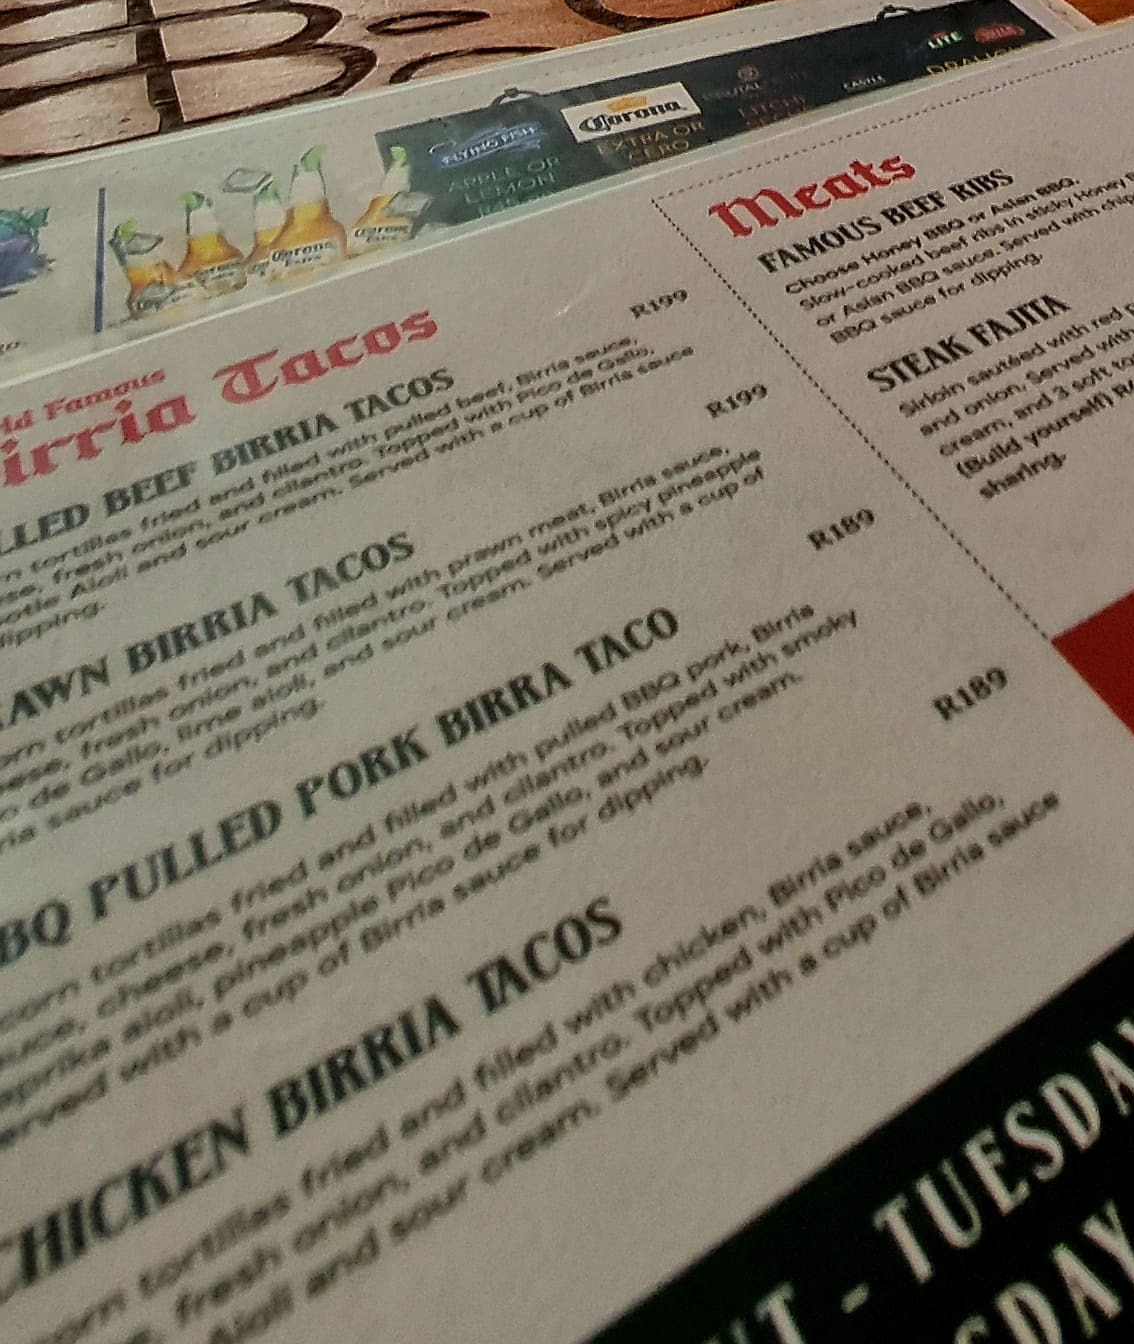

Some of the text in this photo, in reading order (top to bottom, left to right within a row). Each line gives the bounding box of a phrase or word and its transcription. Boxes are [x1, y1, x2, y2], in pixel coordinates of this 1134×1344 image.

[578, 100, 685, 134] Corona
[673, 119, 706, 138] OR
[707, 154, 916, 237] Meats
[756, 168, 1014, 273] FAMOUS BEEF RIBS
[629, 289, 688, 319] R199
[866, 294, 1071, 392] STEAK FAJITA
[0, 309, 438, 487] irria Tacos
[704, 383, 767, 418] R199
[807, 508, 875, 550] R189
[0, 657, 110, 731] AWN
[932, 667, 1007, 721] R189
[0, 607, 679, 972] BQ PULLED PORK BIRRA TACO
